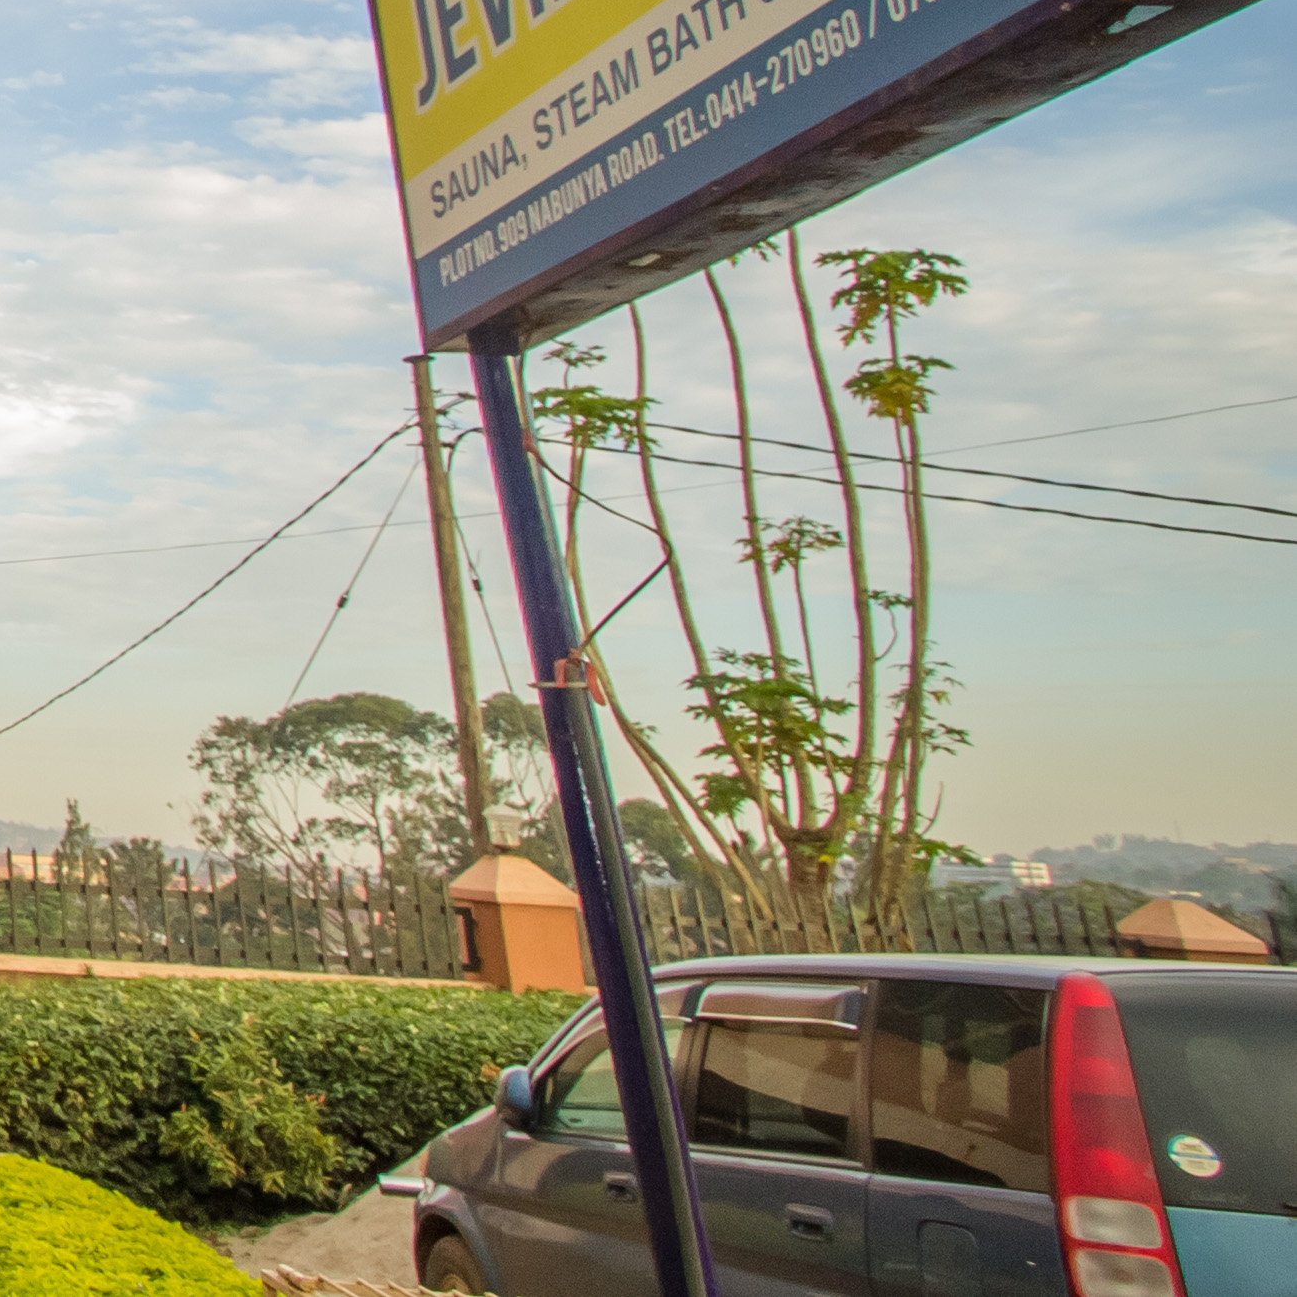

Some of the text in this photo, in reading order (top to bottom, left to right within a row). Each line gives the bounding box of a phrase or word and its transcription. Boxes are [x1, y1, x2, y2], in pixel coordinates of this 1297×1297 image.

[430, 132, 528, 219] SAUNA,
[532, 47, 641, 151] STEAM
[496, 209, 529, 253] 909
[527, 162, 609, 236] NABUNYA
